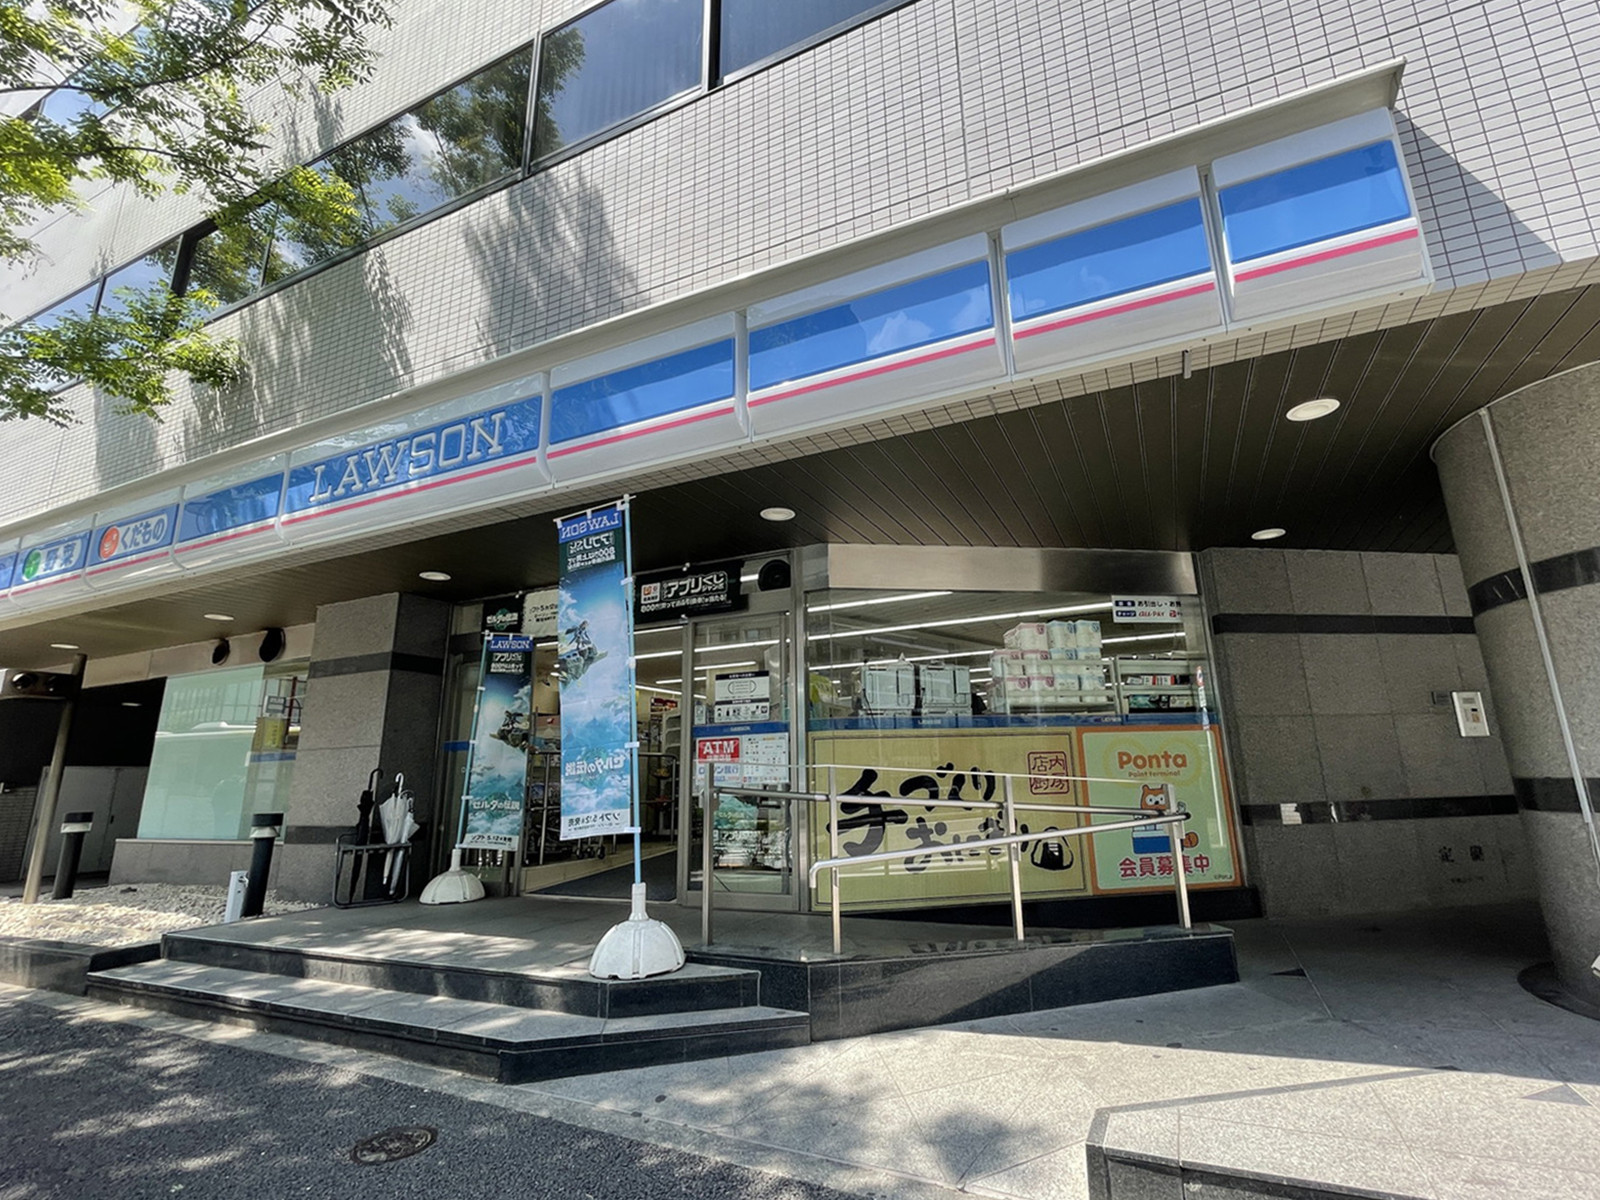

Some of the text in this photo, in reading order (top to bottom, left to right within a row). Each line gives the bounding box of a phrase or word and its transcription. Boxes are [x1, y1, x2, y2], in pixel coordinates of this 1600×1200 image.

[309, 411, 506, 503] LAWSON
[121, 517, 165, 550] くだもの
[43, 541, 77, 572] 野菜
[667, 573, 725, 598] アプリくじ
[490, 640, 530, 649] LAWSON
[703, 740, 735, 755] ATM
[698, 765, 739, 775] ロン銀行
[1031, 755, 1066, 772] 店内
[1117, 750, 1188, 770] Ponta
[1128, 770, 1148, 778] Point
[826, 763, 996, 857] 手づくり
